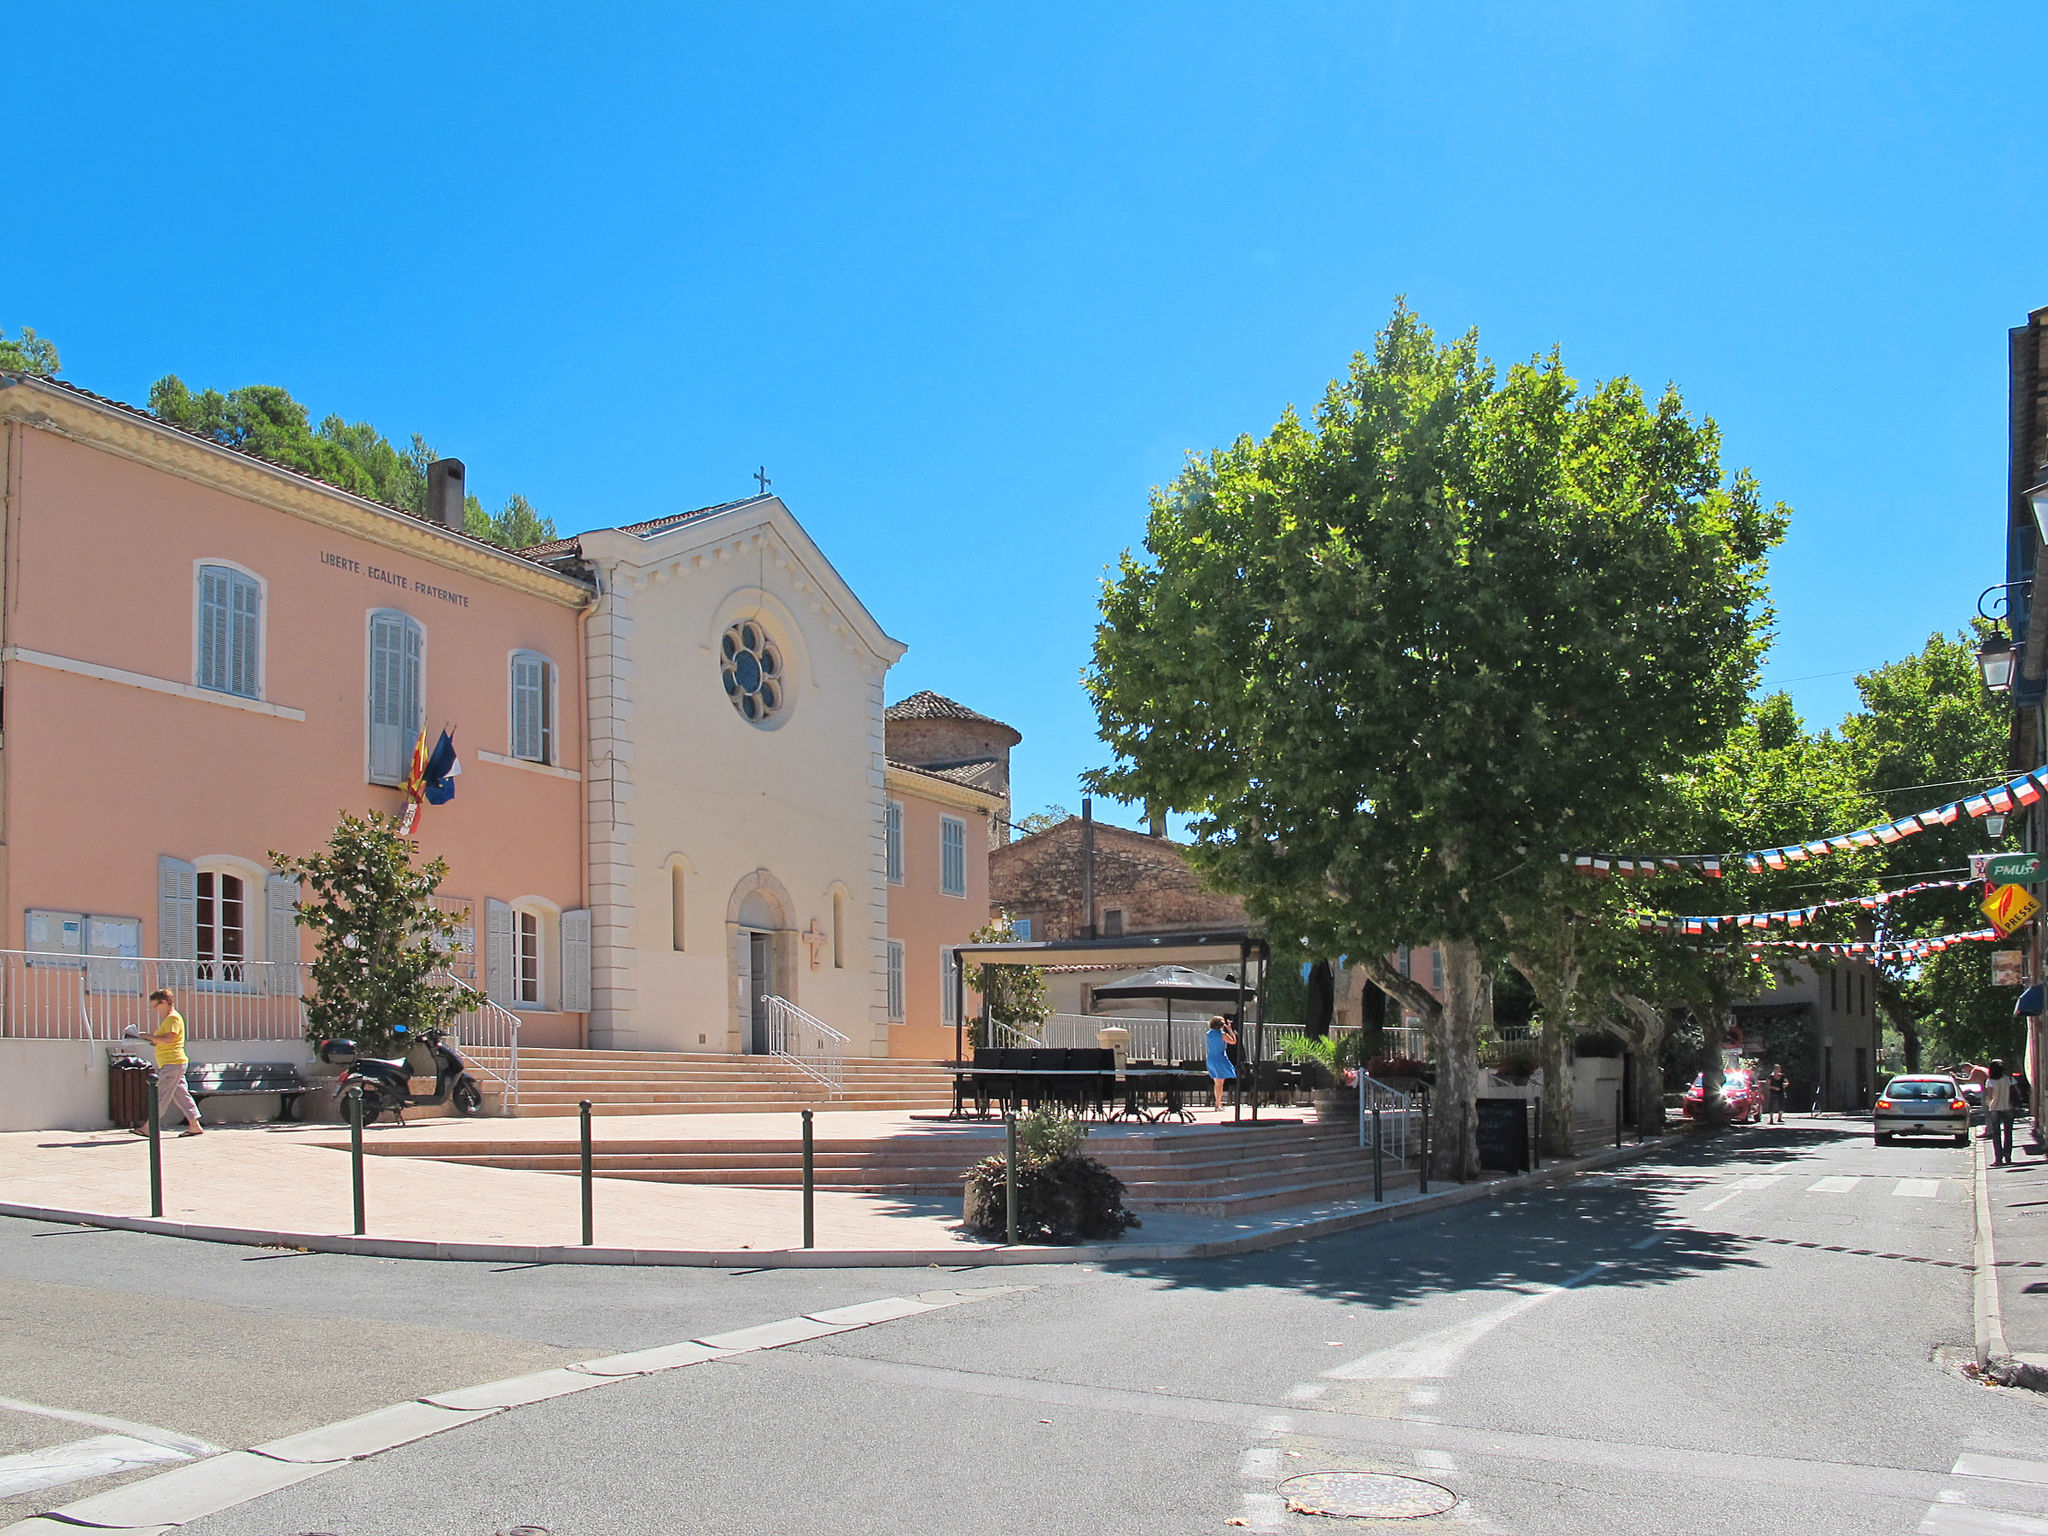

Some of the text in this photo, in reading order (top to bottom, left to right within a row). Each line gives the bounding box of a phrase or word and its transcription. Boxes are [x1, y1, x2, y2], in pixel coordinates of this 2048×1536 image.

[320, 551, 470, 608] LIBERTE EGALITE FRATERNITE
[1993, 864, 2026, 876] PMU
[2004, 901, 2038, 930] PRESSE
